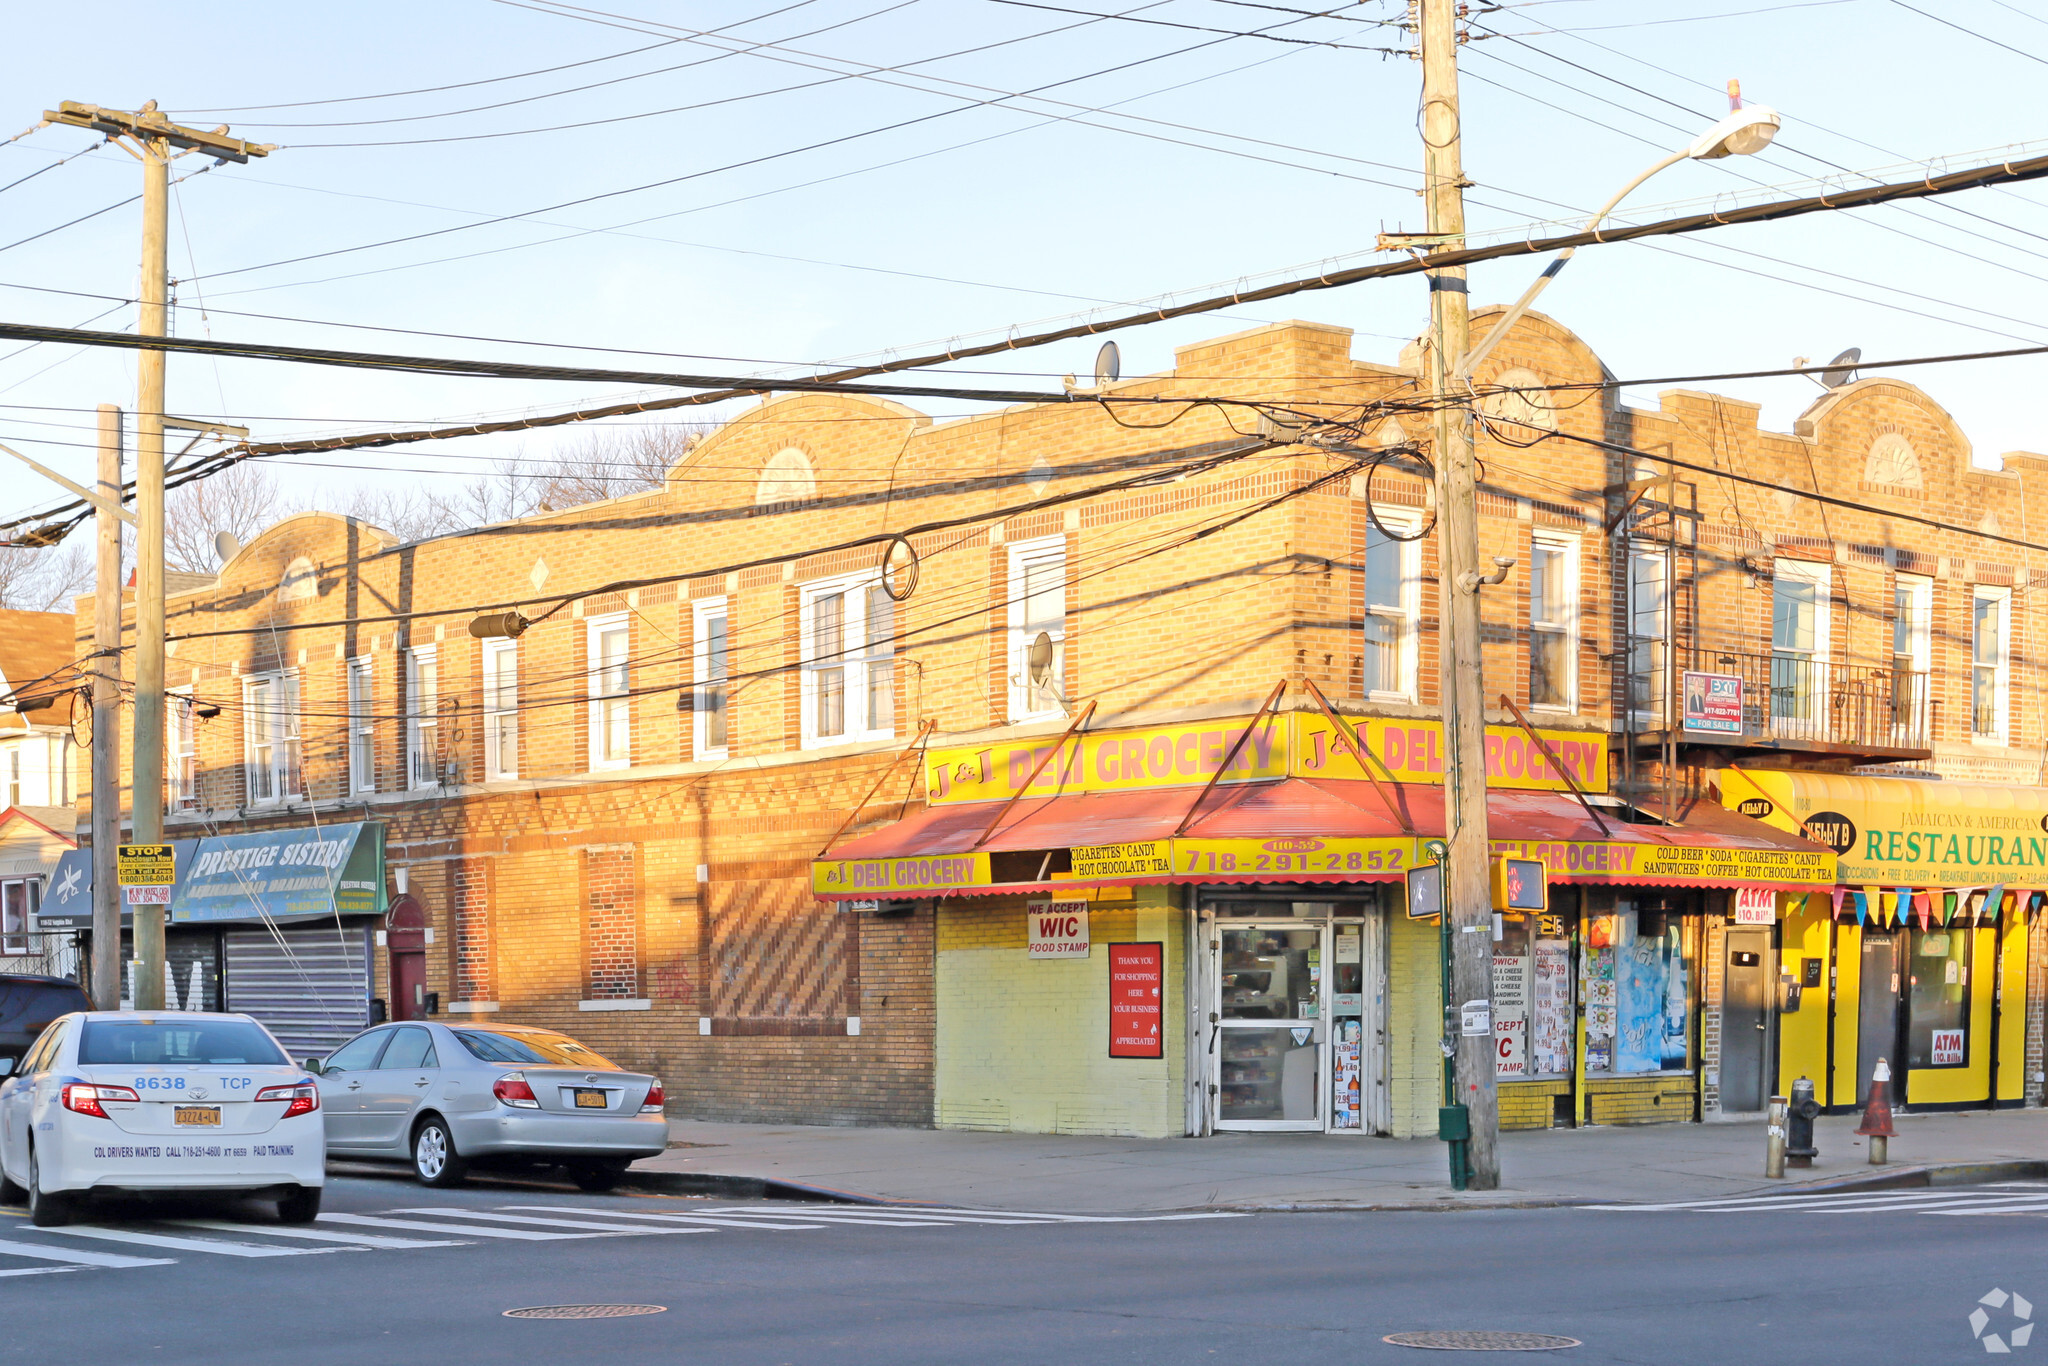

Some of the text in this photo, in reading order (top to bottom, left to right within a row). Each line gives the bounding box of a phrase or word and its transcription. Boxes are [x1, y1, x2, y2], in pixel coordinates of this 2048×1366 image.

[1711, 680, 1738, 695] EXIT
[1697, 720, 1712, 728] FOR
[1712, 721, 1731, 730] SALE
[1009, 744, 1084, 789] DELI
[1095, 725, 1278, 783] GROCERY
[1384, 726, 1442, 773] DEL
[1485, 734, 1600, 783] ROCERY
[1741, 803, 1763, 814] KELLY
[1900, 812, 2039, 831] JAMAICAN & AMERICAN
[1806, 822, 1850, 846] KELLY D
[127, 847, 163, 856] STOP
[1271, 840, 1316, 850] 110-52
[1864, 830, 2048, 867] RESTAURAN
[194, 838, 350, 878] PRESTIGE SISTERS
[1071, 843, 1156, 861] CIGARETTES CANDY
[1535, 843, 1637, 870] GROCERY
[1657, 847, 1822, 866] COLD BEER SODA CIGARETTES CANDY
[120, 855, 156, 863] Foreclosure
[1186, 848, 1404, 871] 718-291-2852
[853, 862, 890, 888] DELI
[895, 858, 975, 887] GROCERY
[1079, 858, 1169, 876] HOT CHOCOLATE TEA
[1643, 861, 1832, 880] SANDWICHES COFFEE HOT CHOCOLATE TEA
[1846, 867, 1880, 880] OCCASIONS
[1888, 868, 1931, 882] FREE DELIVERY
[1939, 870, 1969, 883] BREAKFAST
[1970, 871, 1990, 883] LUNCH
[1996, 872, 2018, 884] DINNER
[340, 880, 376, 891] PRESTIGE SISTERS
[1738, 887, 1772, 908] ATM
[1028, 902, 1086, 914] WE ACCEPT
[1039, 916, 1079, 938] WIC
[1029, 942, 1088, 953] FOOD STAMP
[1117, 957, 1154, 965] THANK YOU
[1114, 973, 1157, 981] FOR SHOPPING
[1128, 989, 1144, 997] HERE
[1113, 1005, 1159, 1013] YOUR BUSINESS
[1132, 1021, 1139, 1029] IS
[1115, 1037, 1156, 1046] APPRECIATED
[1934, 1034, 1961, 1051] ATM
[1947, 1052, 1961, 1063] Bills
[134, 1077, 186, 1090] 8638
[219, 1077, 252, 1090] TCP
[94, 1145, 294, 1158] CDL DRIVERS WANTED CALL 718-251-4600 XT 6659 PAID TRAINING
